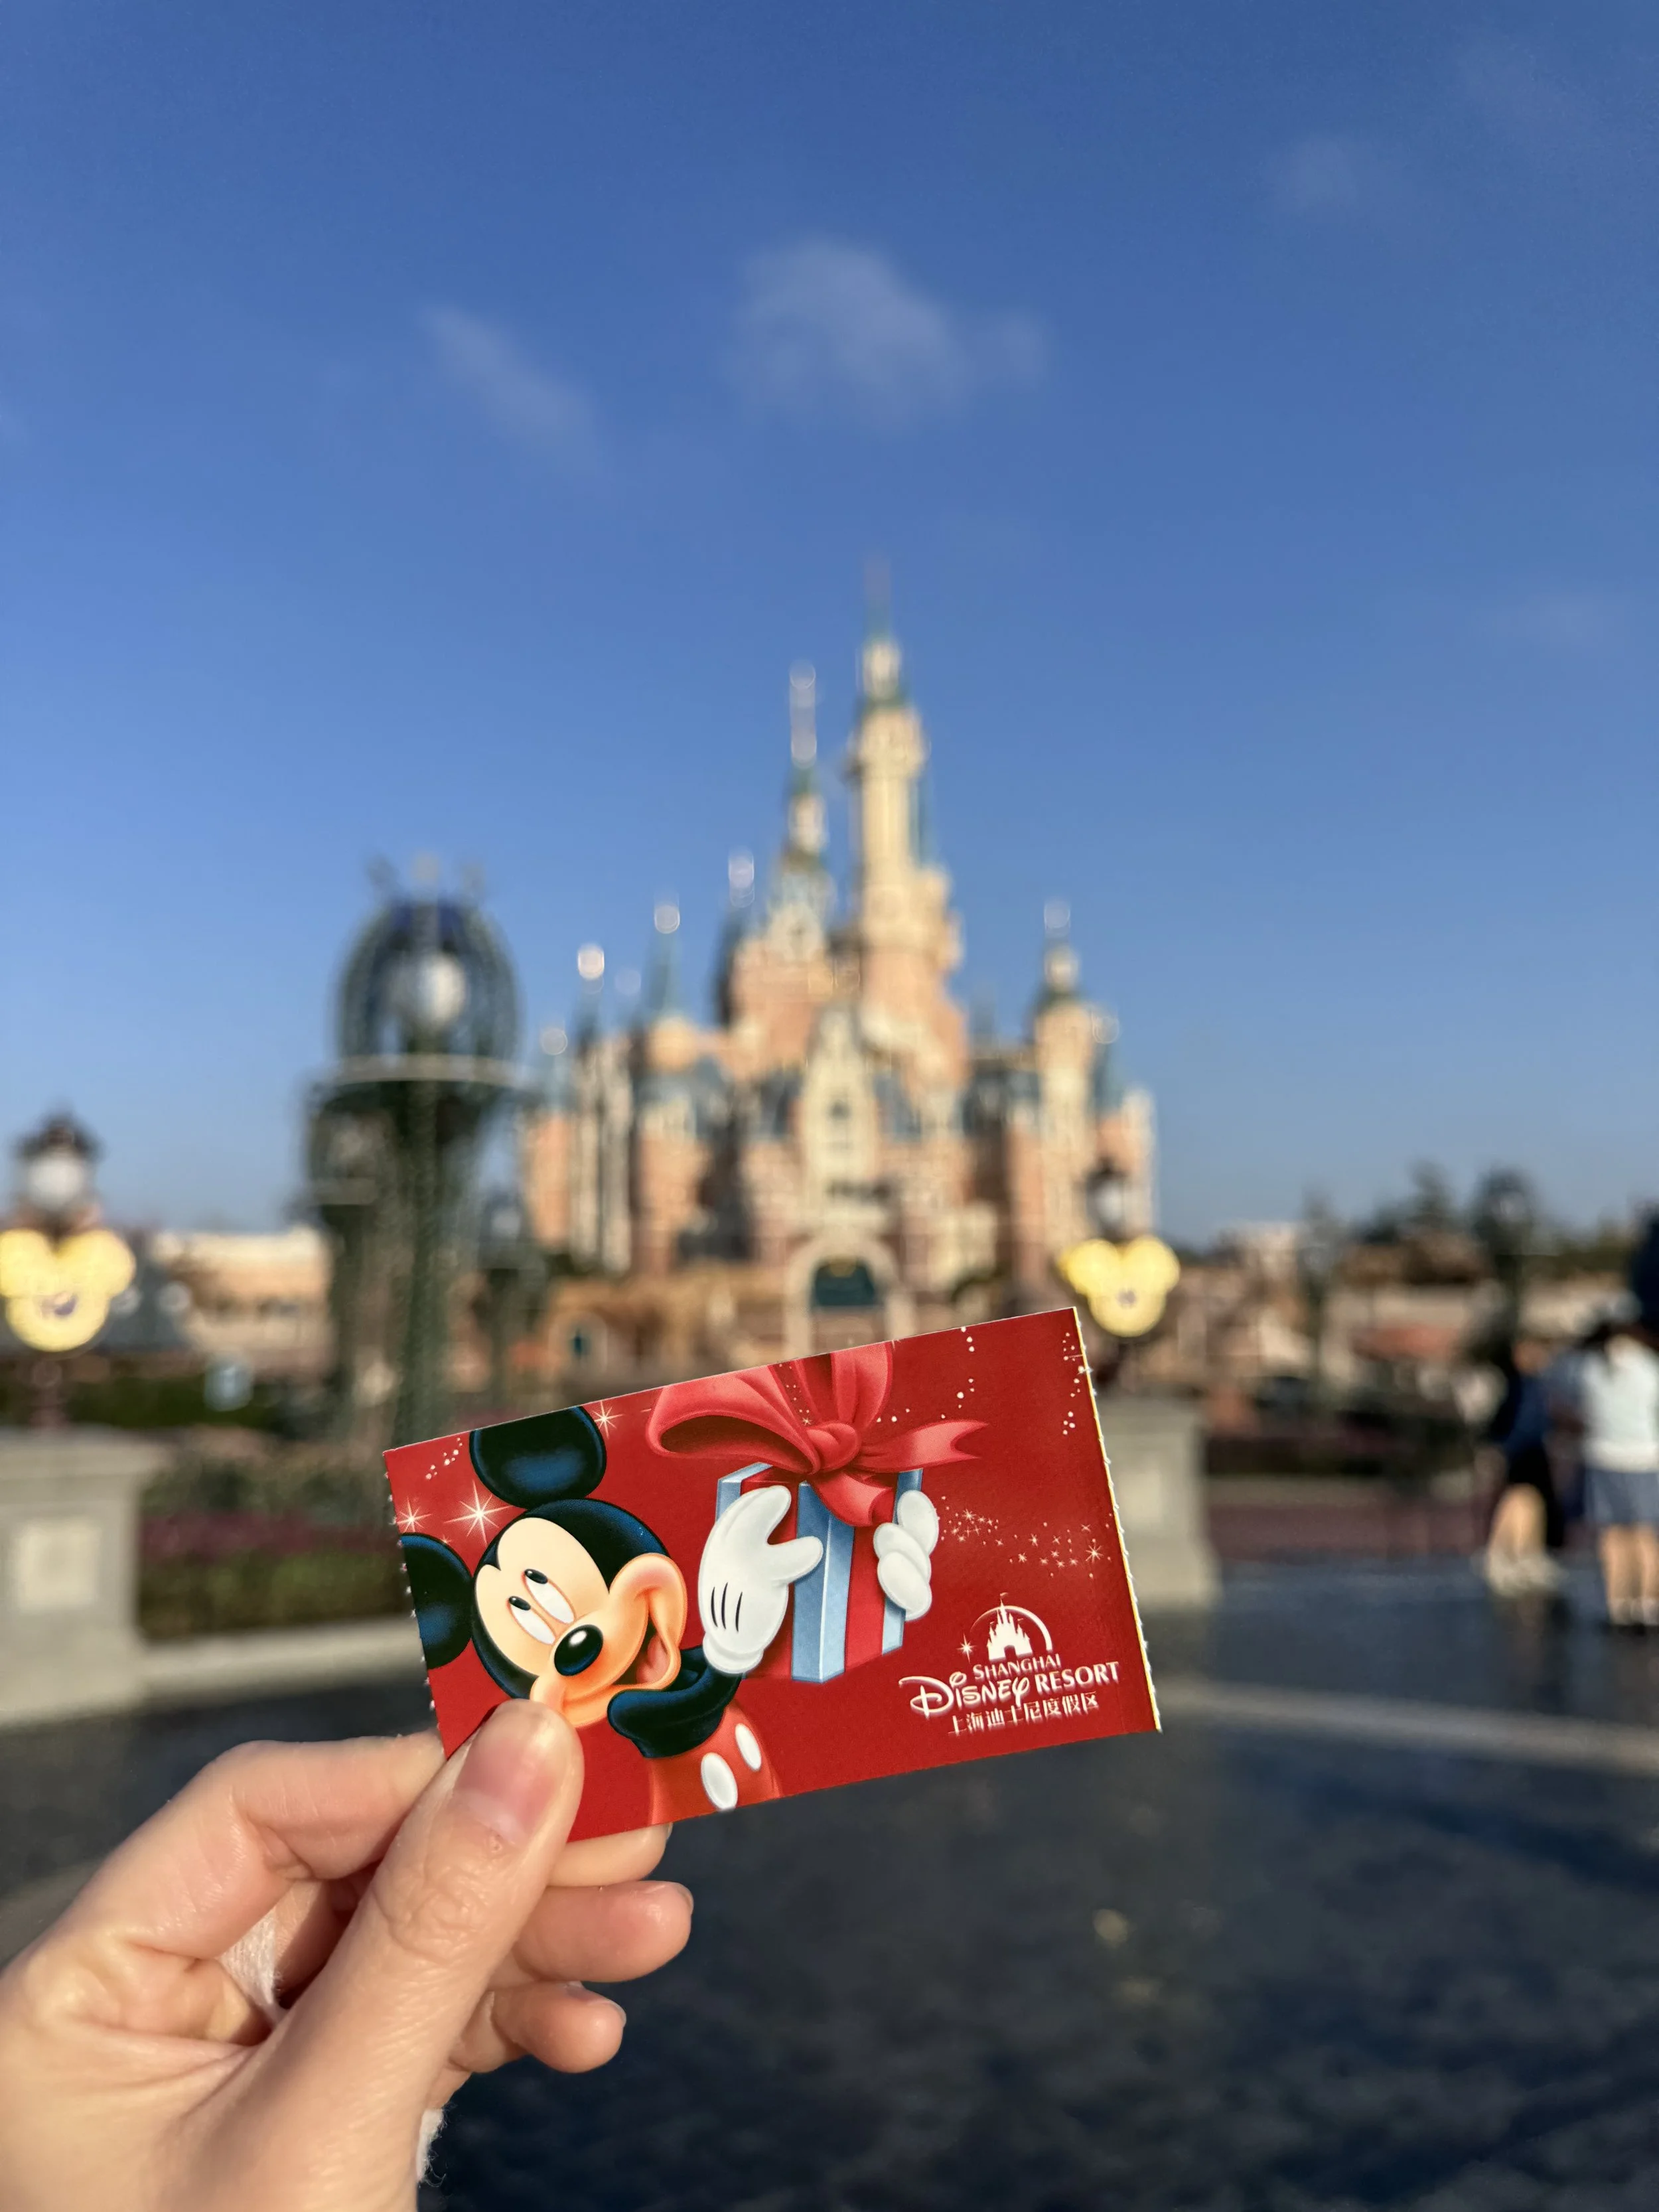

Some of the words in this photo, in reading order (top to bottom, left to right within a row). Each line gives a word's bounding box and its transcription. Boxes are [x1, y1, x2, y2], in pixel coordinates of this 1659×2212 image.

[973, 1654, 1062, 1680] SHANGHAI
[1036, 1661, 1119, 1695] RESORT
[948, 1691, 1100, 1735] 上海迪士尼度假区
